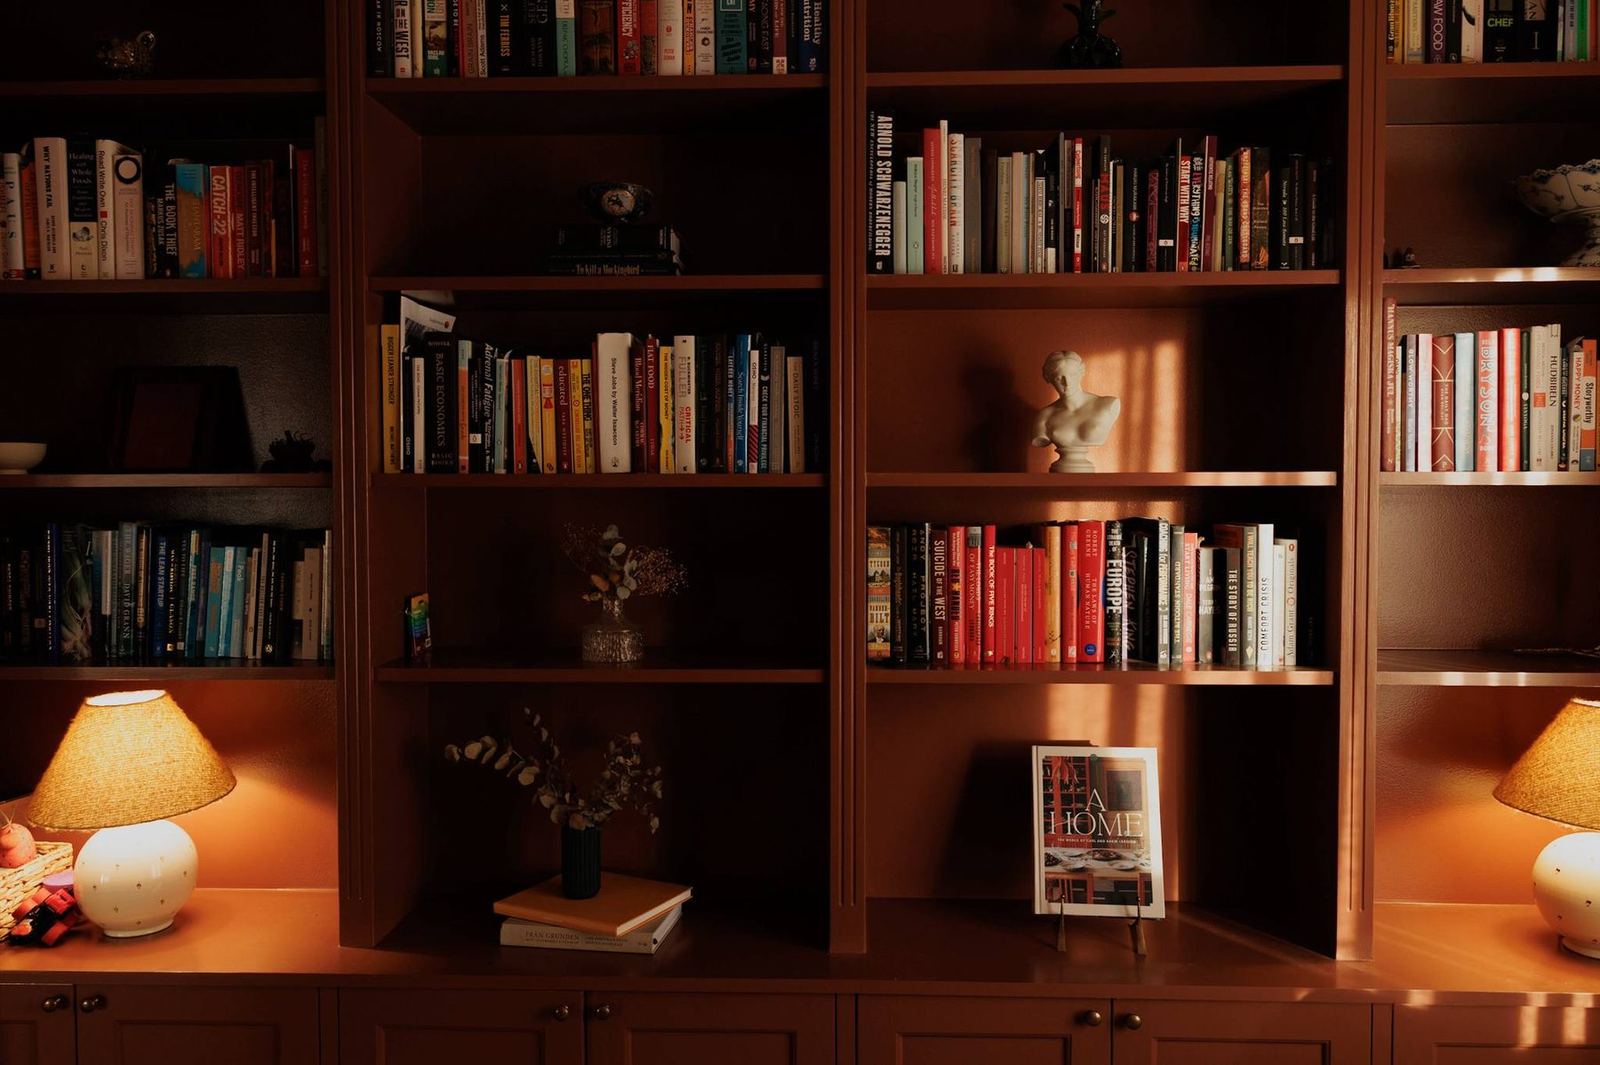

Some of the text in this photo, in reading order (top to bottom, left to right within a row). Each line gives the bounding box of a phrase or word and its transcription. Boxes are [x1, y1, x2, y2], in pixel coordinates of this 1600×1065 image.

[812, 2, 822, 45] Healthy
[1433, 18, 1443, 51] FOOD
[1487, 18, 1514, 27] CHEF
[396, 31, 409, 58] WEST
[43, 146, 51, 162] WHY
[98, 150, 106, 169] Read
[213, 175, 226, 235] CATCH-22
[875, 115, 893, 256] ARNOLD SCHWARZENEGGER
[1180, 160, 1190, 223] START WITH WHY
[165, 184, 177, 256] THE BOOK THIEF
[100, 221, 108, 261] Chris Dixon
[236, 213, 245, 270] MATT RIDLEY
[484, 343, 493, 418] Adrenal Fatigue
[559, 366, 568, 405] educated
[582, 373, 592, 421] THE ONE THING
[647, 365, 655, 389] FOOD
[1386, 381, 1394, 397] JUL
[1480, 347, 1496, 426] BRYSON
[1549, 355, 1558, 407] HUDBIBELN
[1574, 357, 1582, 410] HAPPY MONEY
[436, 353, 445, 446] BASIC ECONOMICS
[1584, 383, 1594, 424] Storyworthy
[1159, 522, 1168, 551] COACHING
[158, 542, 166, 607] THE LEAN STARTUP
[934, 540, 945, 576] SUICIDE
[1159, 552, 1168, 563] for
[936, 577, 943, 585] OF
[988, 579, 995, 589] OF
[1107, 560, 1122, 614] EUROPE
[1127, 550, 1137, 651] STEPHEN KING
[935, 597, 945, 621] WEST
[1228, 569, 1237, 652] THE STORY OF RUSSIA
[1085, 788, 1106, 811] A
[1048, 811, 1143, 837] HOME
